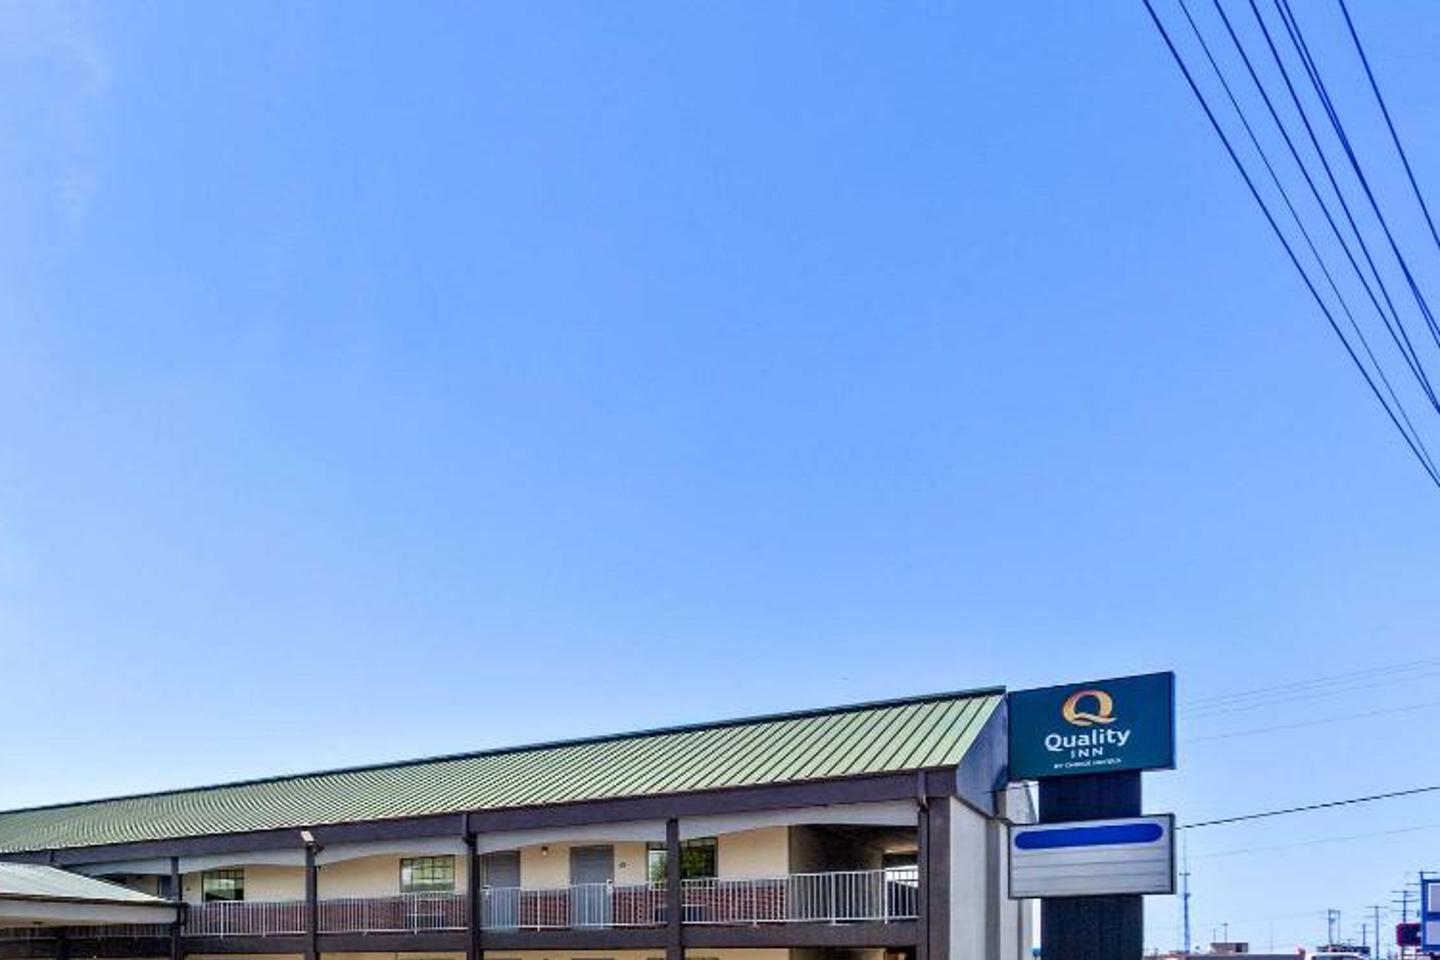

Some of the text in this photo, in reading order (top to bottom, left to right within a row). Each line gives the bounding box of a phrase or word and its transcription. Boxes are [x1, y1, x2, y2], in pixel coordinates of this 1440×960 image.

[1063, 691, 1117, 726] Q
[1044, 729, 1131, 751] Quality
[1071, 746, 1103, 759] INN
